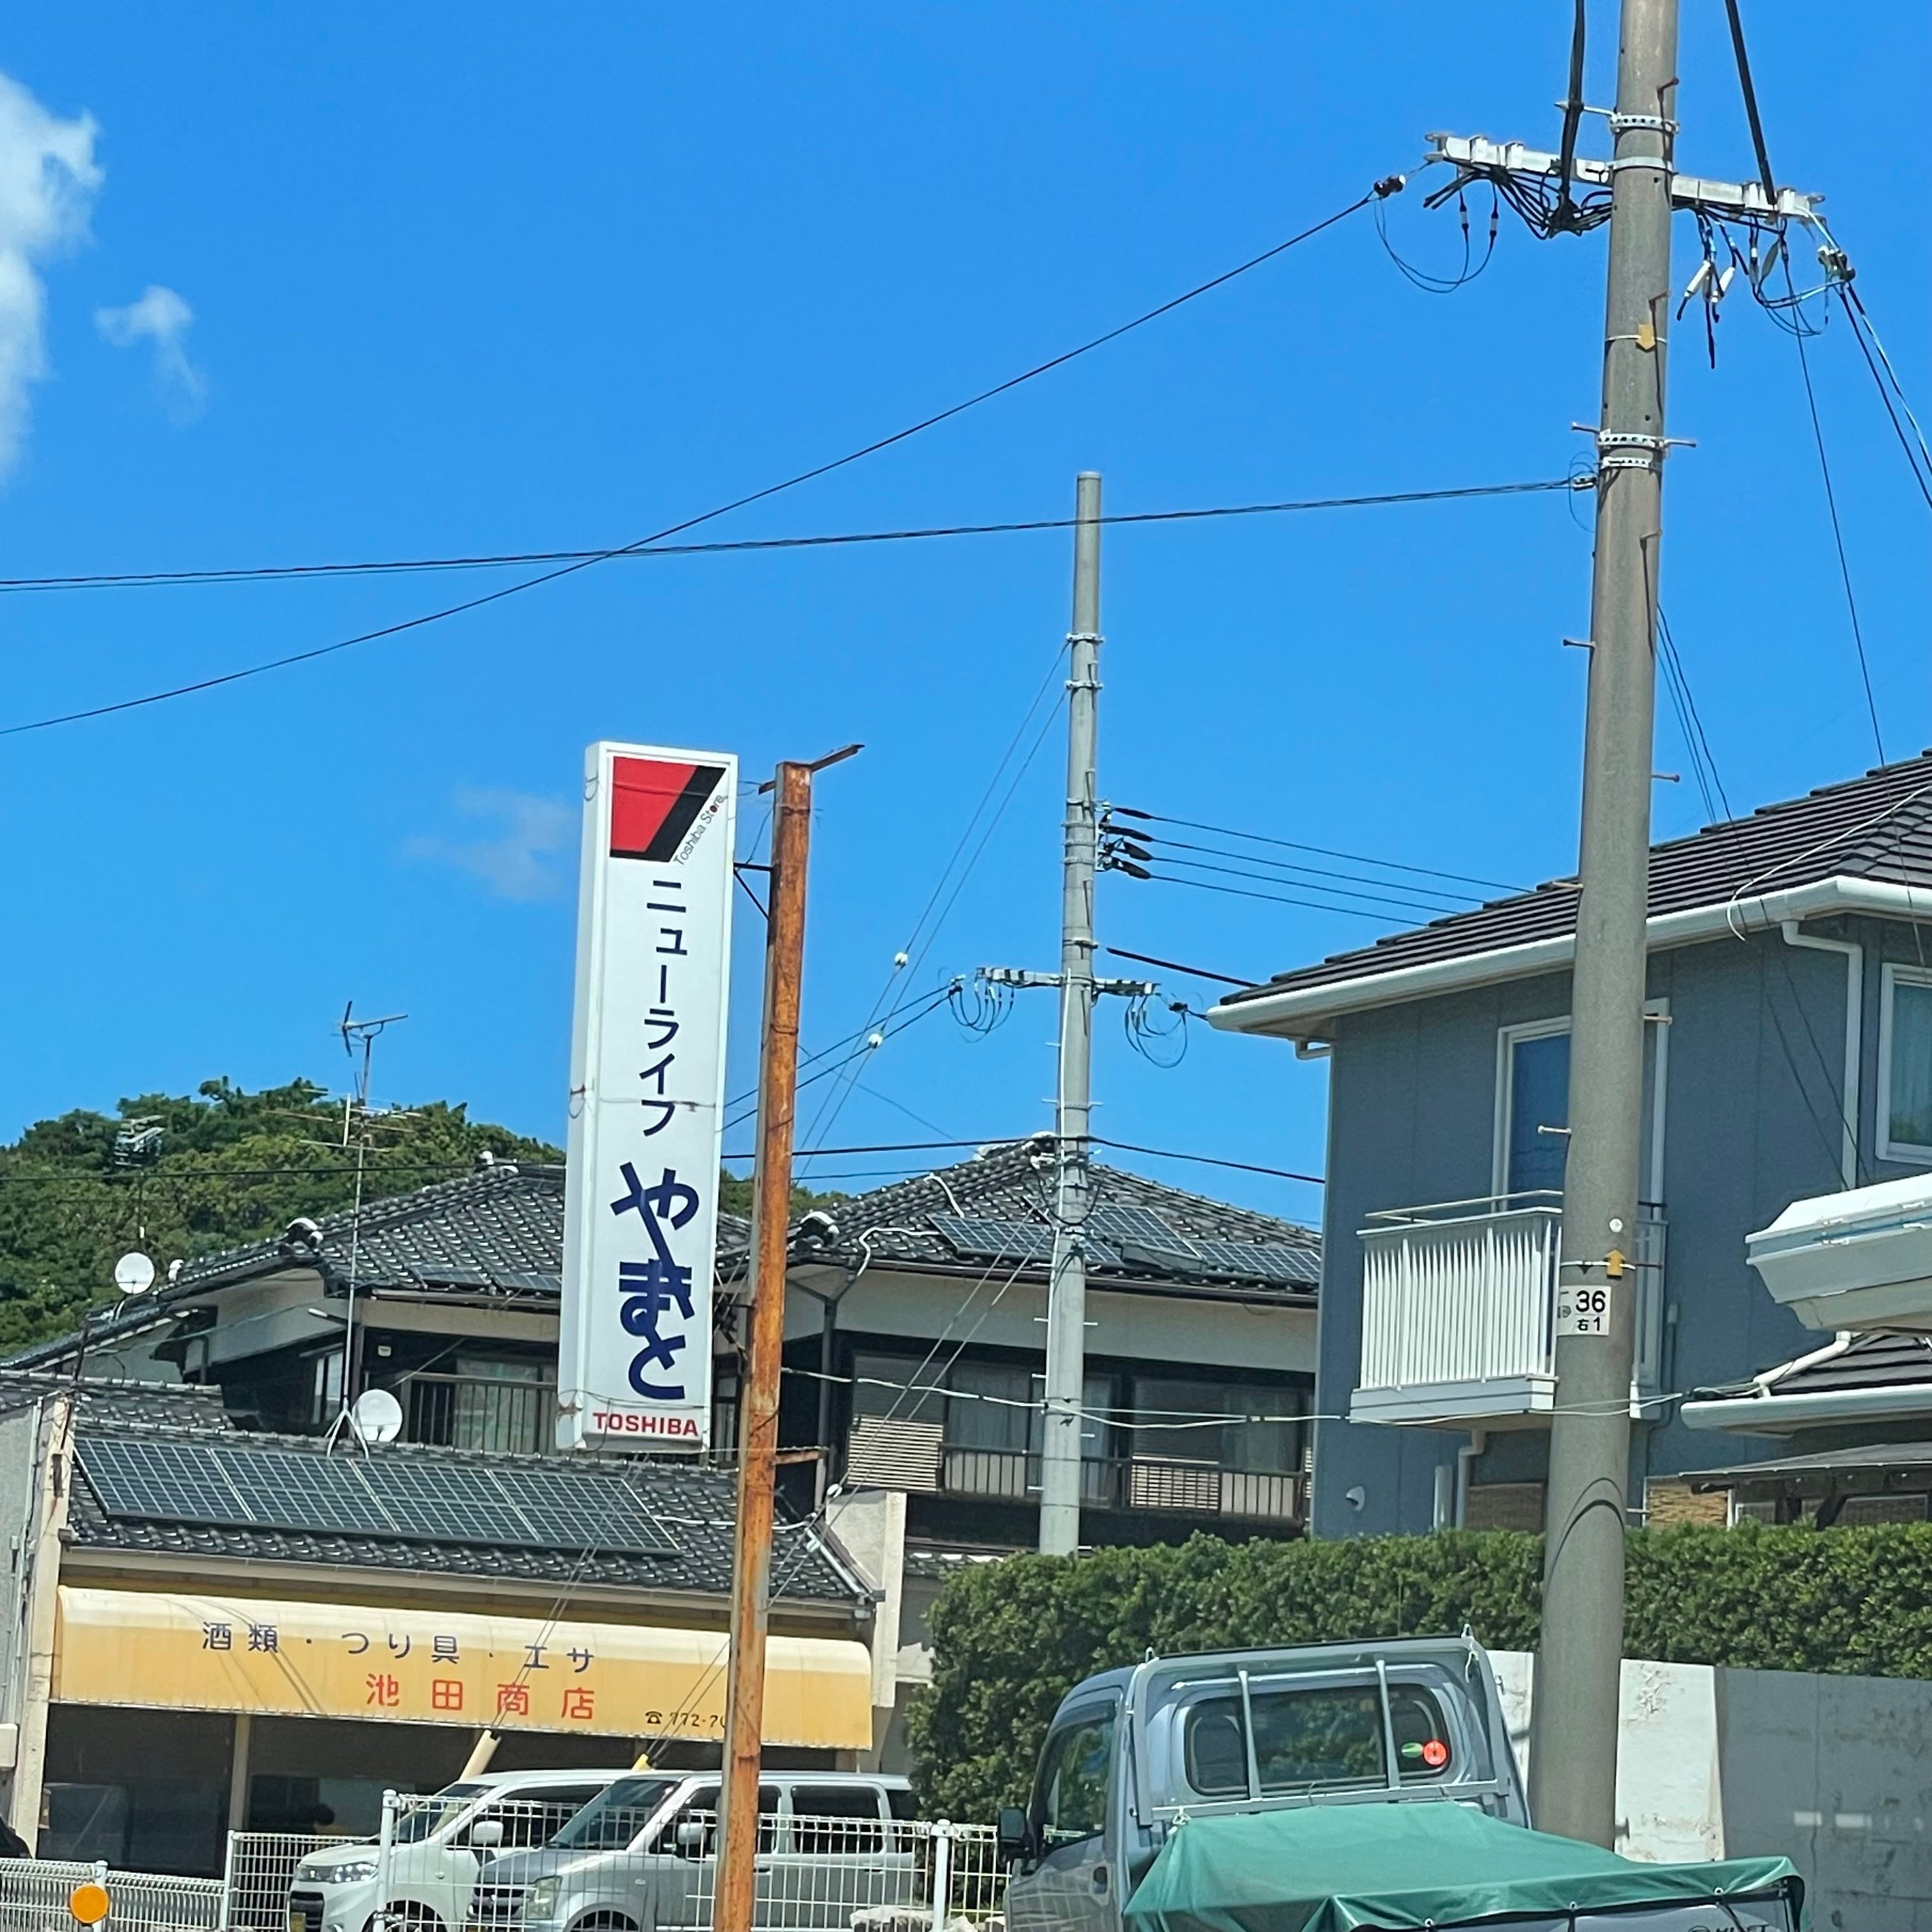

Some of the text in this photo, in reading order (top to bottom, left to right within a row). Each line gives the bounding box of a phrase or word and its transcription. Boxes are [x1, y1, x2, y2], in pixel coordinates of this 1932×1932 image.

[673, 794, 726, 866] Toshiba Store
[639, 879, 687, 1137] ニューライフ
[609, 1161, 700, 1400] やまと
[1575, 1290, 1606, 1313] 36
[592, 1412, 699, 1437] TOSHIBA
[365, 1672, 595, 1720] 池田商店
